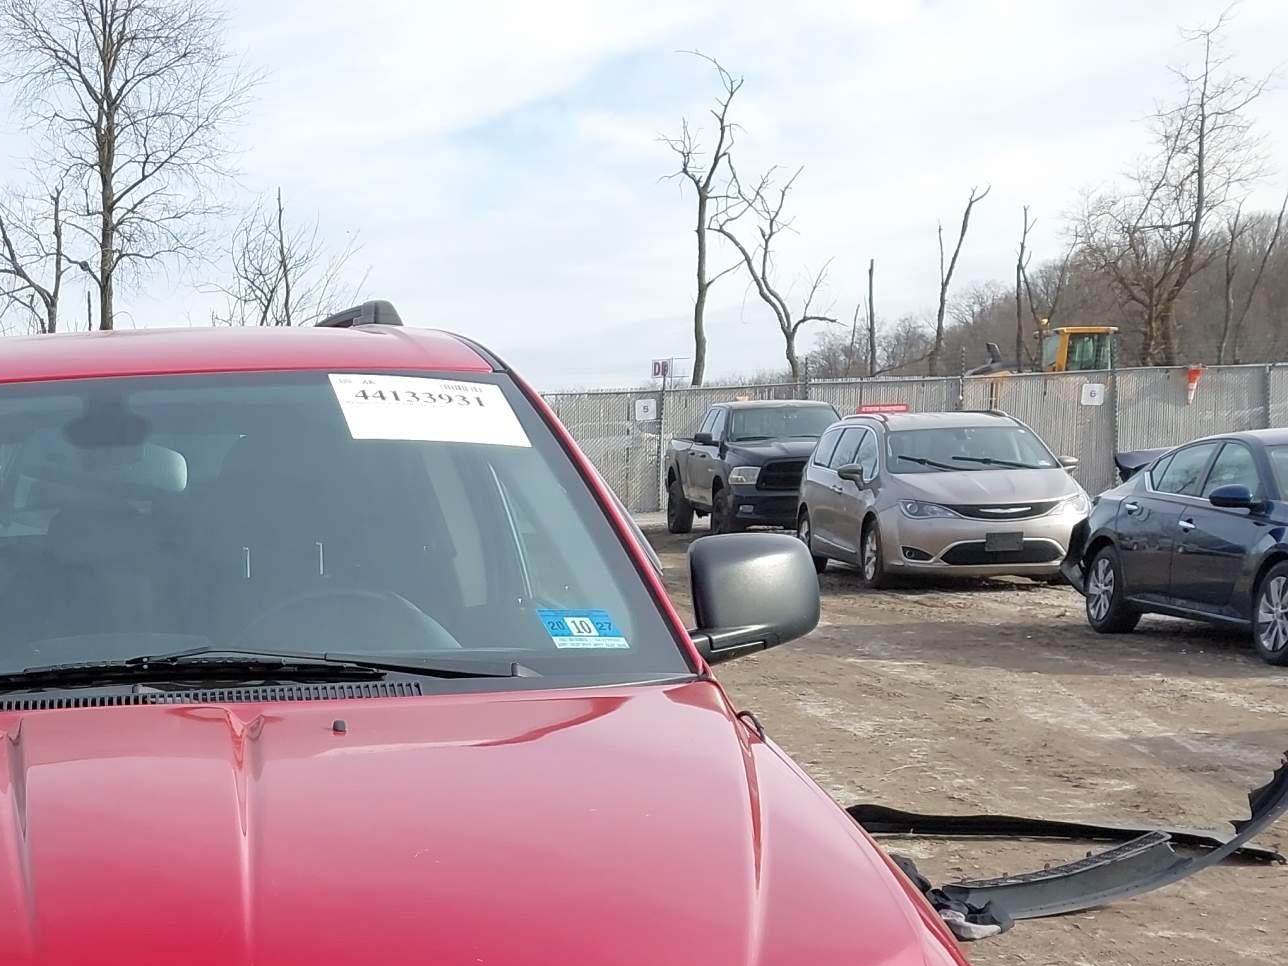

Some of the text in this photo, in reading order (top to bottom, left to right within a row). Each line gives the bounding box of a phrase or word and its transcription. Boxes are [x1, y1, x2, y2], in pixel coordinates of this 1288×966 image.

[354, 389, 485, 407] 44133931
[547, 620, 612, 634] 20 10 27
